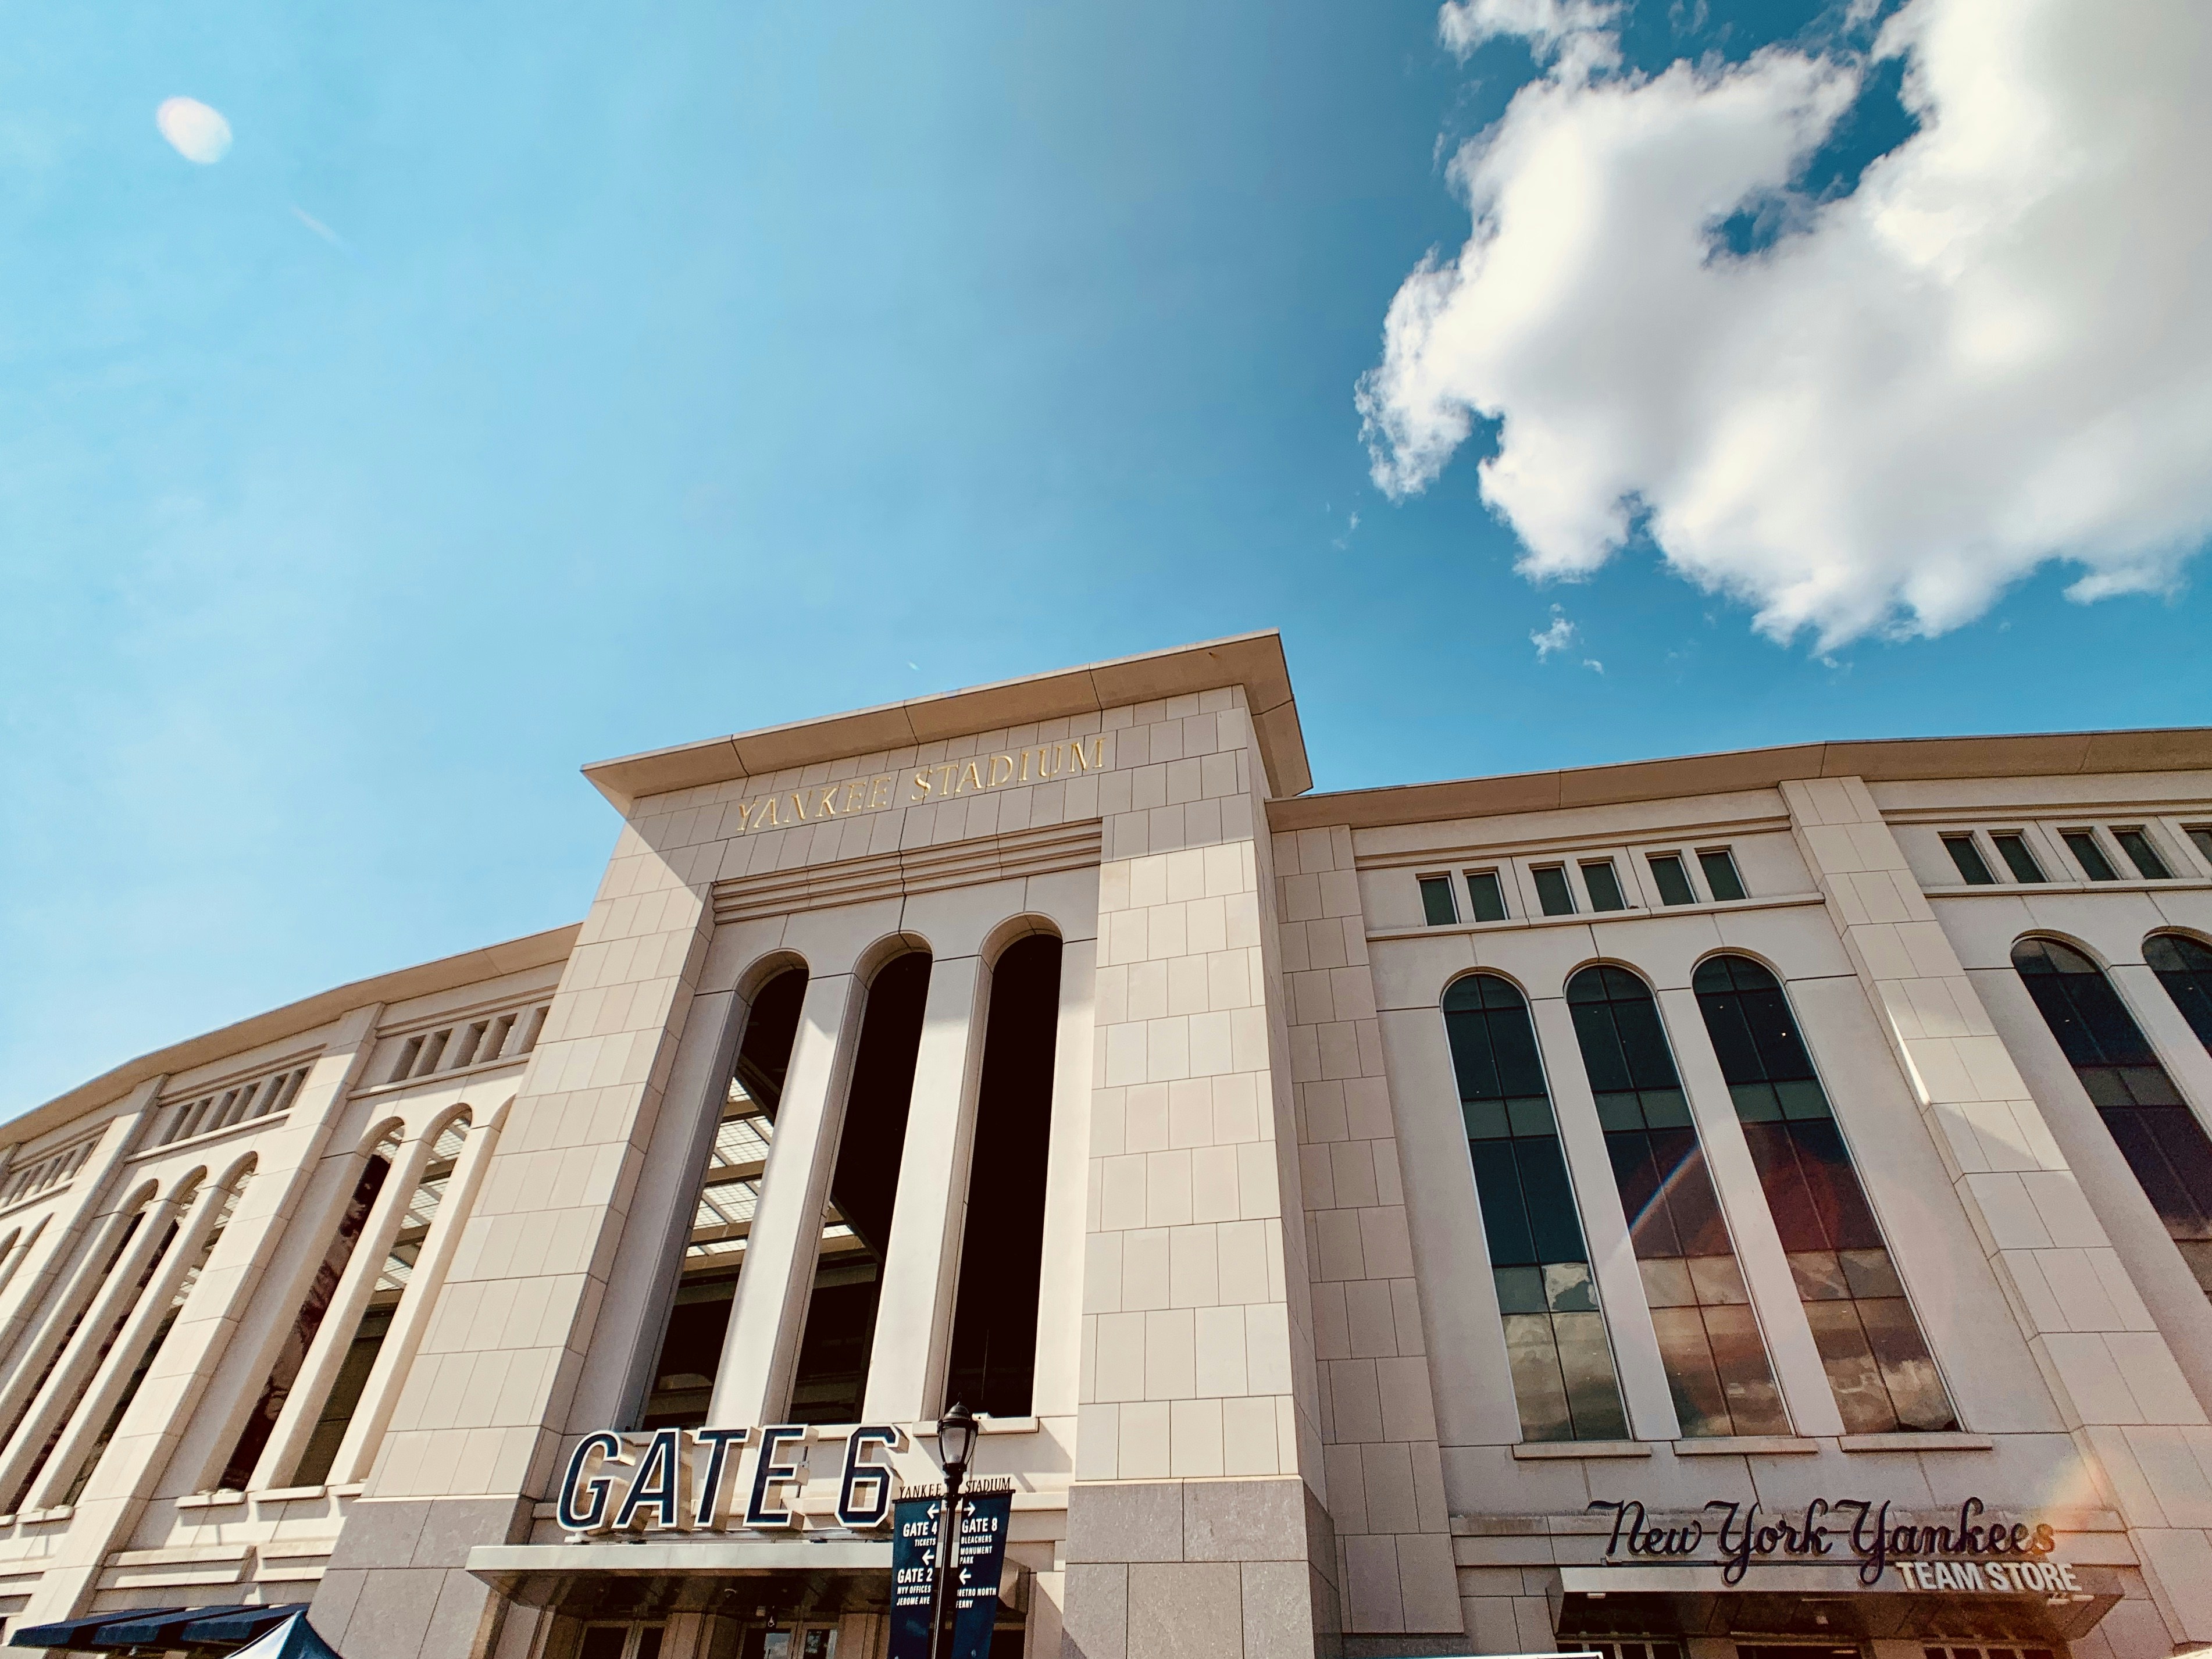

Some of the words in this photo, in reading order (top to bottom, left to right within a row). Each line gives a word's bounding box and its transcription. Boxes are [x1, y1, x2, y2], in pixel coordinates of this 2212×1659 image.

[737, 777, 891, 831] YANKEE
[911, 737, 1106, 801] STADIUM
[556, 1423, 810, 1532] GATE
[835, 1423, 900, 1528] 6
[900, 1483, 942, 1499] YANKEE
[965, 1477, 1011, 1493] STADIUM
[902, 1522, 929, 1537] GATE
[932, 1521, 937, 1535] 4
[962, 1517, 989, 1533] GATE
[991, 1517, 998, 1532] 8
[915, 1538, 936, 1547] TICKETS
[961, 1535, 992, 1544] BLEACHERS
[1587, 1499, 1703, 1556] New
[1704, 1497, 1833, 1586] York
[1834, 1496, 2056, 1586] Yankees
[960, 1546, 993, 1555] MONUMENT
[959, 1556, 974, 1565] PARK
[897, 1568, 924, 1584] GATE
[926, 1568, 933, 1582] 2
[1896, 1562, 1983, 1591] TEAM
[1984, 1562, 2083, 1592] STORE
[897, 1586, 909, 1594] NYY
[909, 1585, 932, 1594] OFFICES
[977, 1587, 996, 1596] NORTH
[896, 1597, 918, 1606] JEROME
[919, 1596, 930, 1605] AVE
